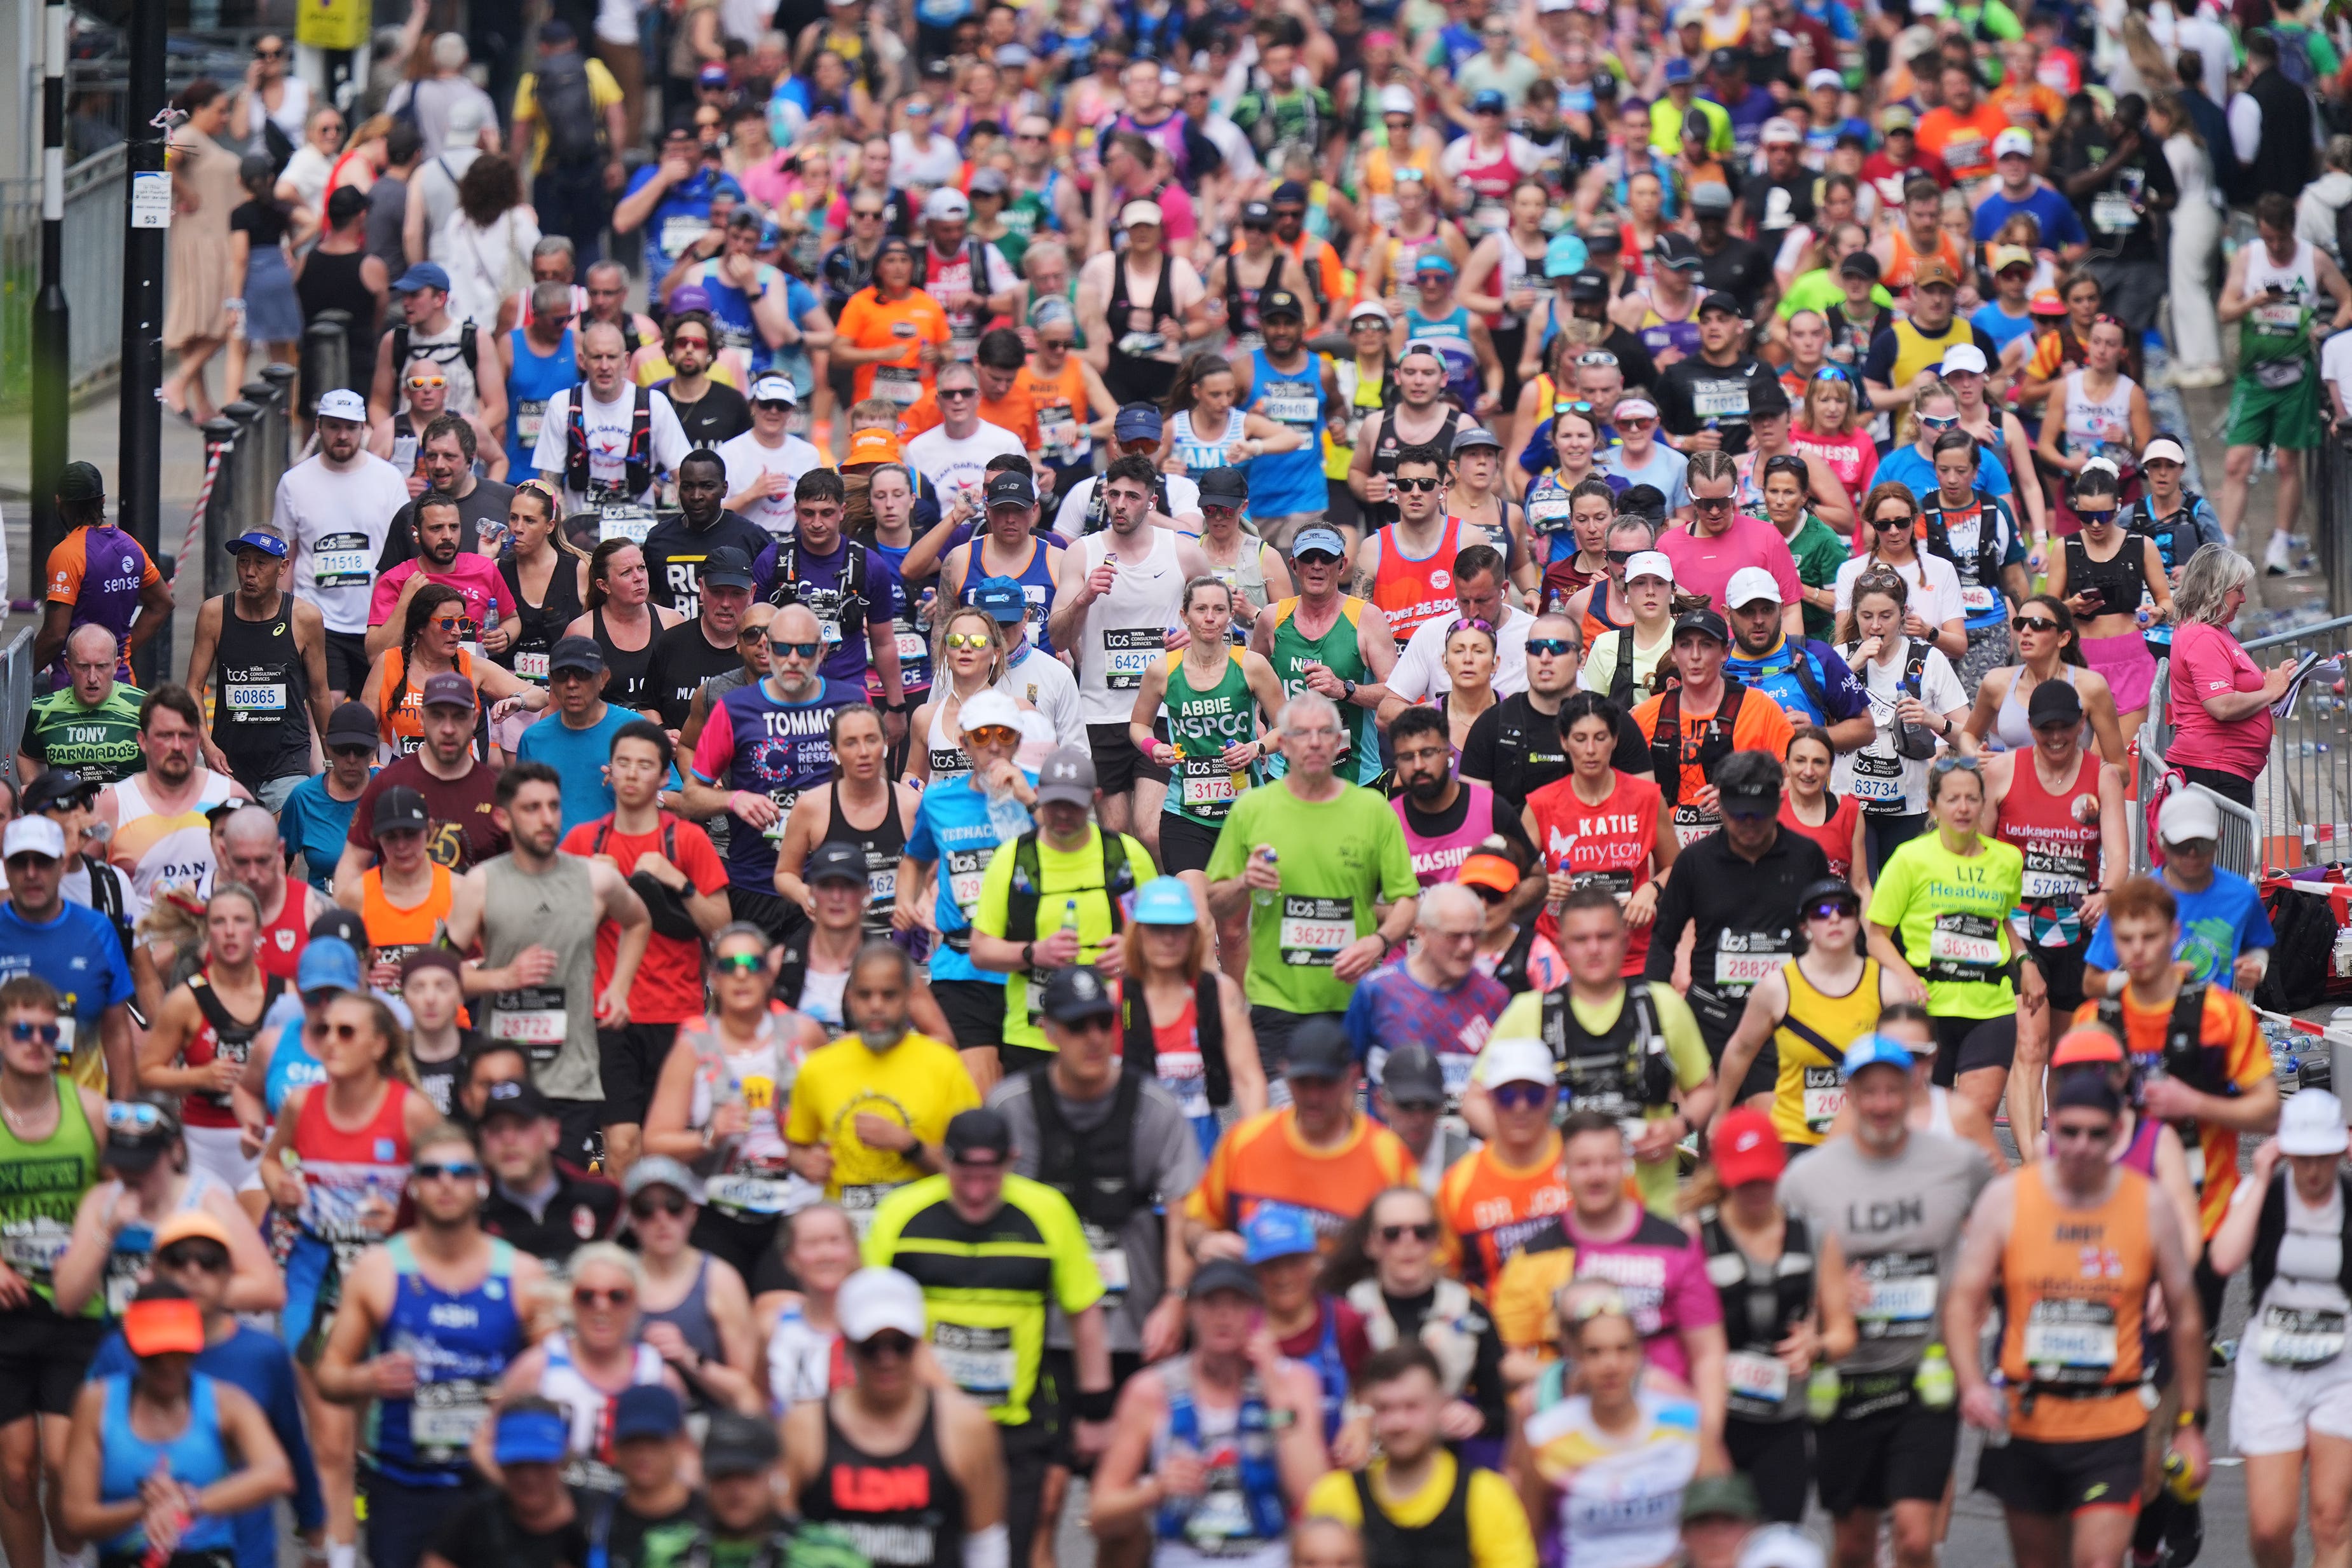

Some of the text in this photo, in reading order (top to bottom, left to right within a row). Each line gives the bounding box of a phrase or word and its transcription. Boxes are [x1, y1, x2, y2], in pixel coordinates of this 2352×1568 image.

[322, 556, 362, 569] 71518
[104, 575, 140, 593] sense
[1386, 607, 1414, 624] Over
[1107, 632, 1129, 647] tcs
[521, 657, 549, 674] 311
[227, 667, 248, 682] tcs
[234, 689, 275, 704] 60865
[1181, 697, 1233, 717] ABBIE
[1172, 711, 1249, 739] NSPCC
[66, 726, 107, 742] TONY
[47, 742, 138, 765] BARNARDO'S
[932, 752, 955, 768] tcs
[798, 765, 814, 775] UK
[1187, 760, 1210, 775] tcs
[1855, 779, 1898, 796] 63734
[1681, 806, 1704, 823] tcs
[1579, 814, 1638, 837] KATIE
[2006, 823, 2077, 840] Leukaemia
[1576, 841, 1641, 866] myton
[2026, 840, 2084, 859] SARAH
[2028, 854, 2052, 871] tcs
[1957, 865, 1986, 882] LIZ
[1931, 880, 2005, 906] Headway
[2034, 878, 2079, 895] 57877
[1286, 897, 1315, 918] tcs
[1294, 927, 1346, 944] 36277
[1721, 927, 1748, 952] tcs
[1807, 1067, 1835, 1087] tcs
